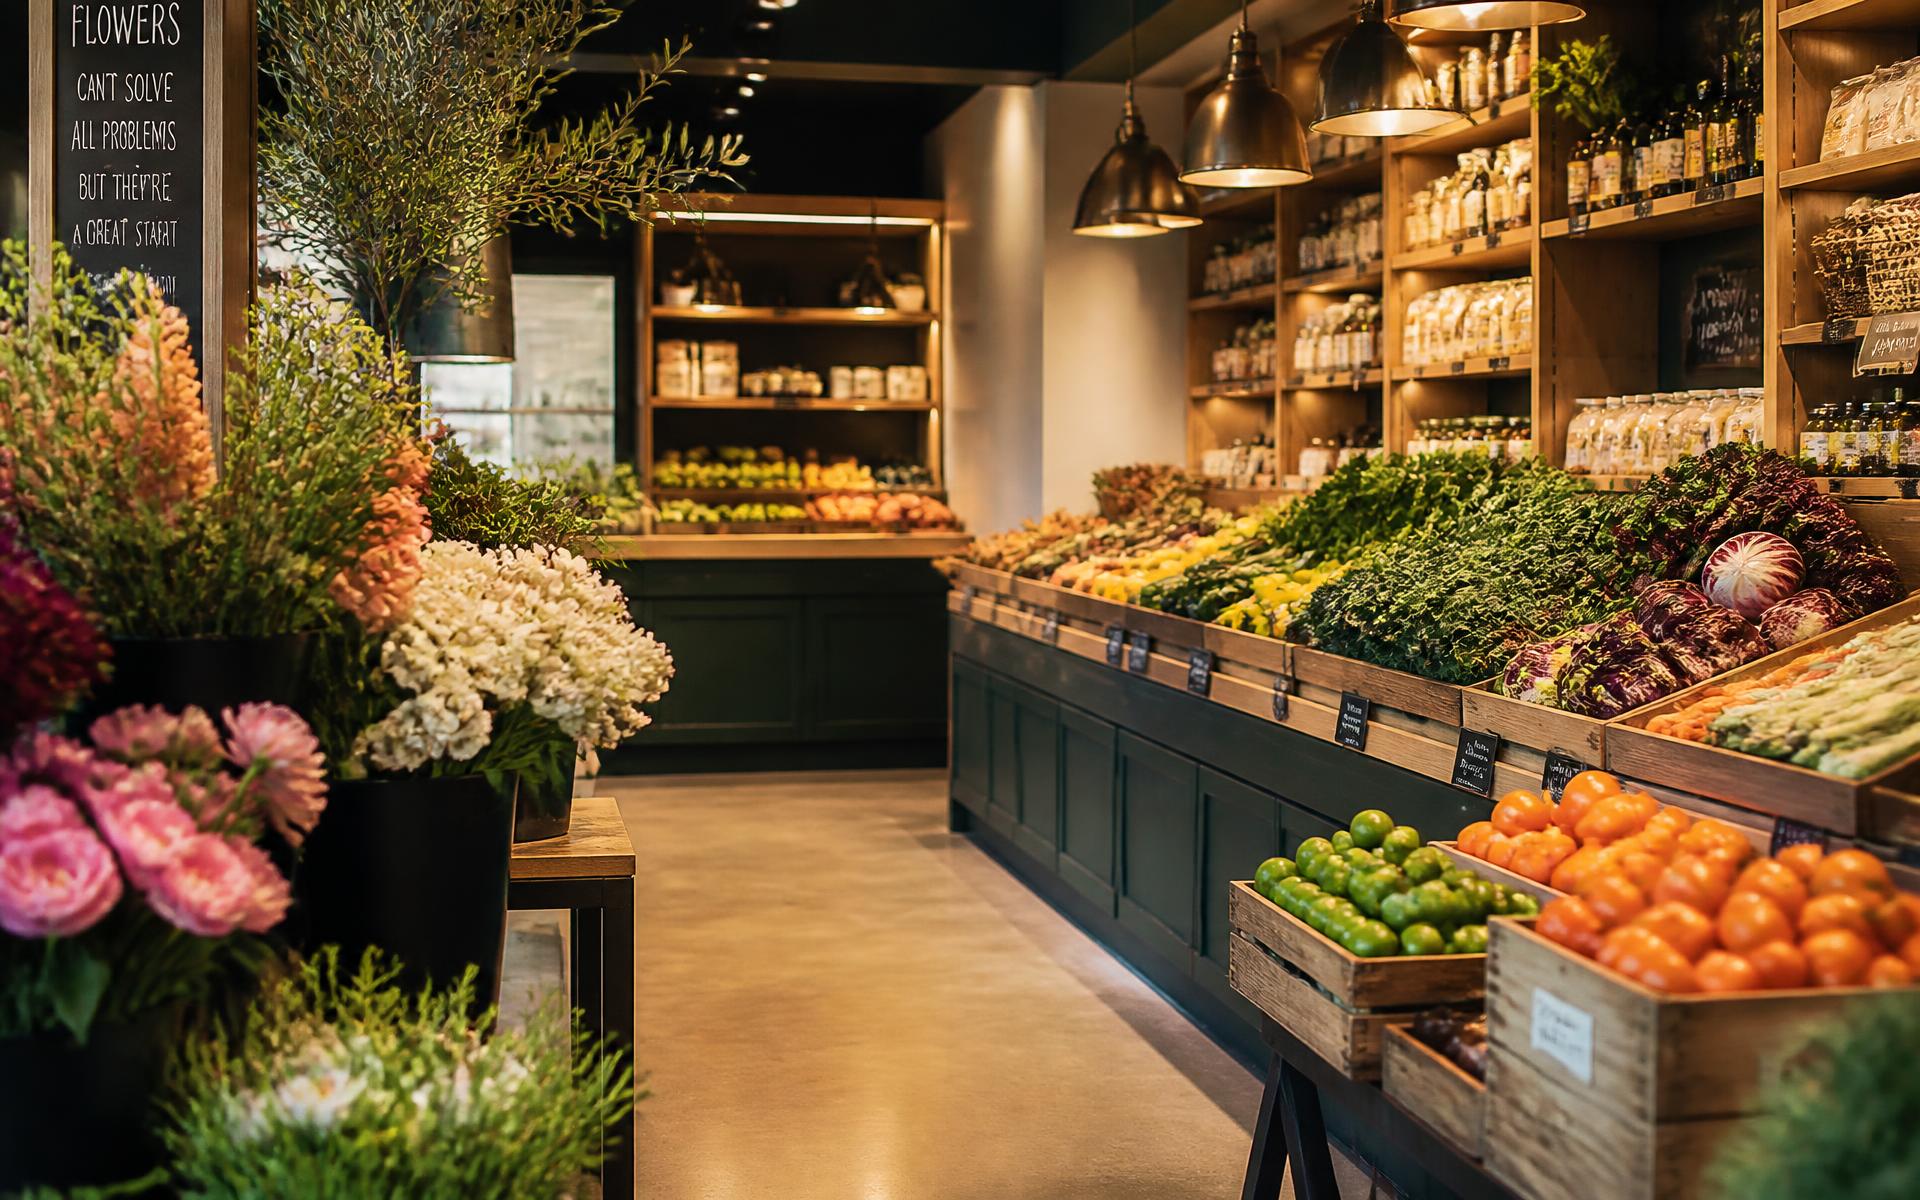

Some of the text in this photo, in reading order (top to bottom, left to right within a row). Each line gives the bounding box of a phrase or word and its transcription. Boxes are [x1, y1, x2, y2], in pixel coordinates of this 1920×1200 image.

[72, 2, 181, 48] FLOWERS
[124, 71, 174, 103] SOLVE
[71, 119, 177, 152] ALL PROBLEMS
[79, 172, 107, 201] BUT
[73, 223, 82, 246] A
[86, 217, 128, 247] GREAT
